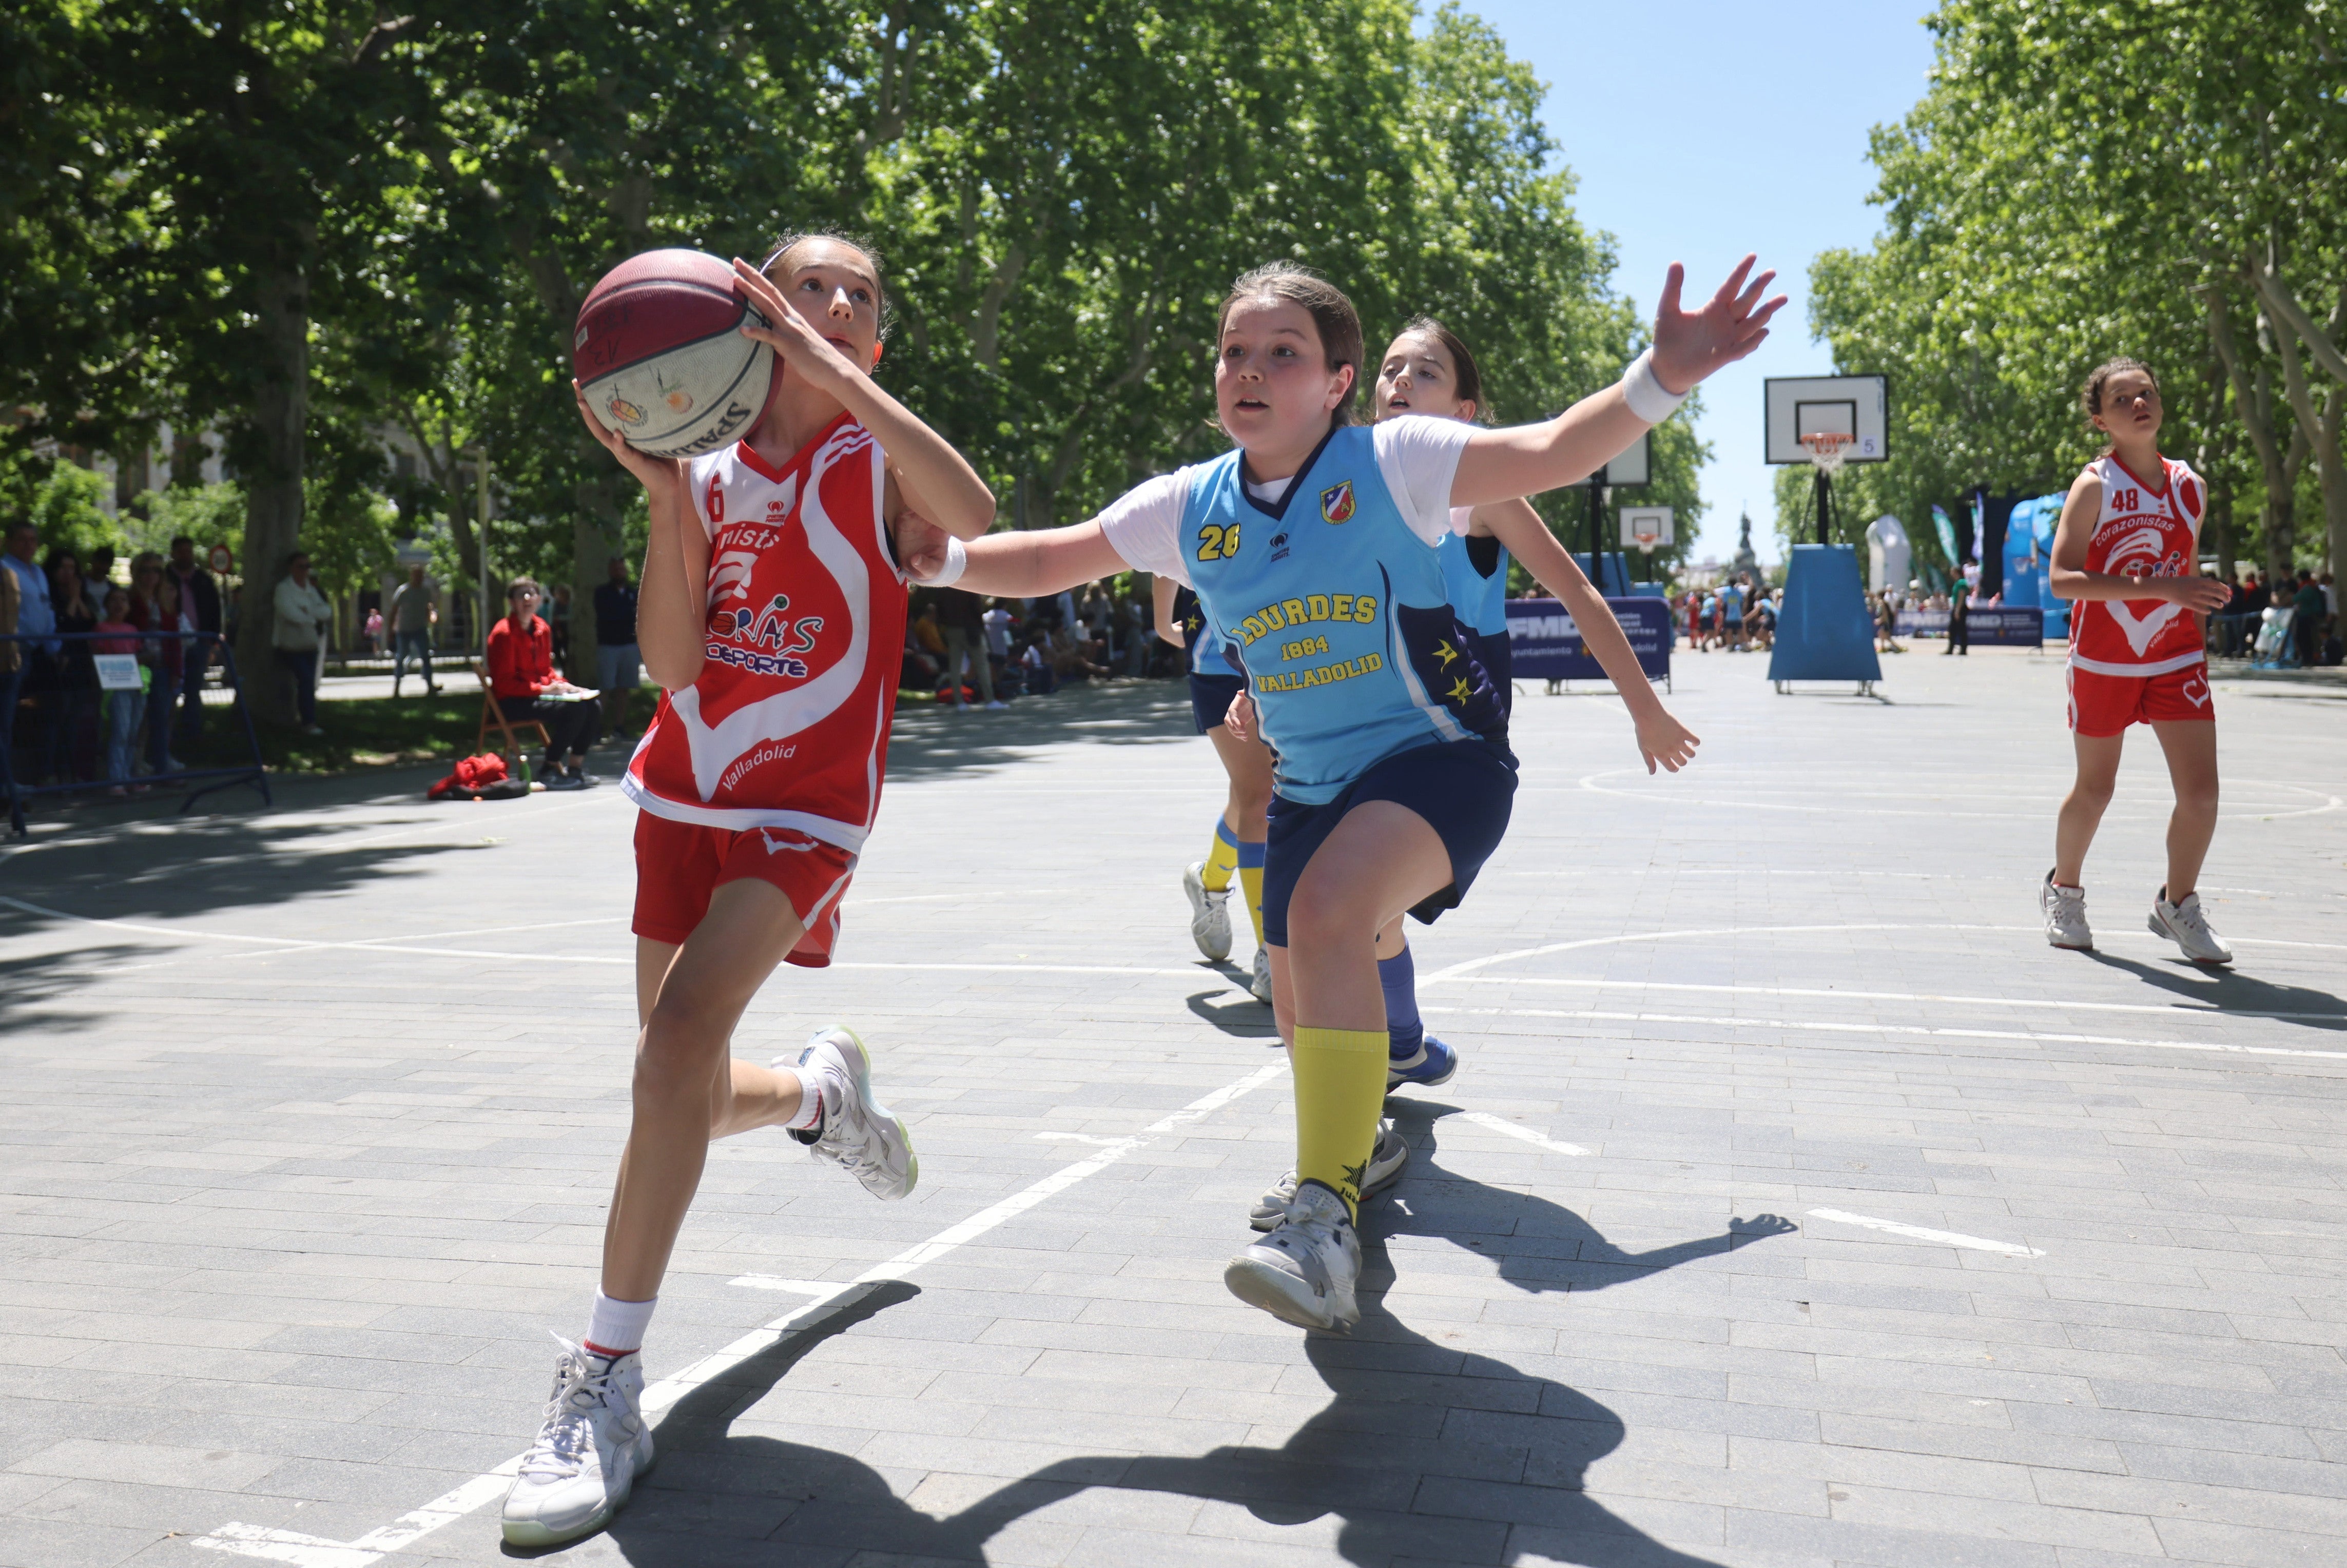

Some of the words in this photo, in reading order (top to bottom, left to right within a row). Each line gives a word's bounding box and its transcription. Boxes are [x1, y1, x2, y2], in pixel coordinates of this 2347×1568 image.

[1864, 439, 1874, 453] 5
[2111, 487, 2139, 512] 48
[1197, 521, 1241, 562] 26
[2096, 514, 2175, 546] corazonistas
[1230, 594, 1377, 647] LOURDES
[706, 643, 808, 677] DEPORTE
[1281, 635, 1329, 661] 1884
[1510, 646, 1573, 658] yuntamiento
[1256, 652, 1383, 693] VALLADOLID
[722, 744, 797, 791] Valladolid
